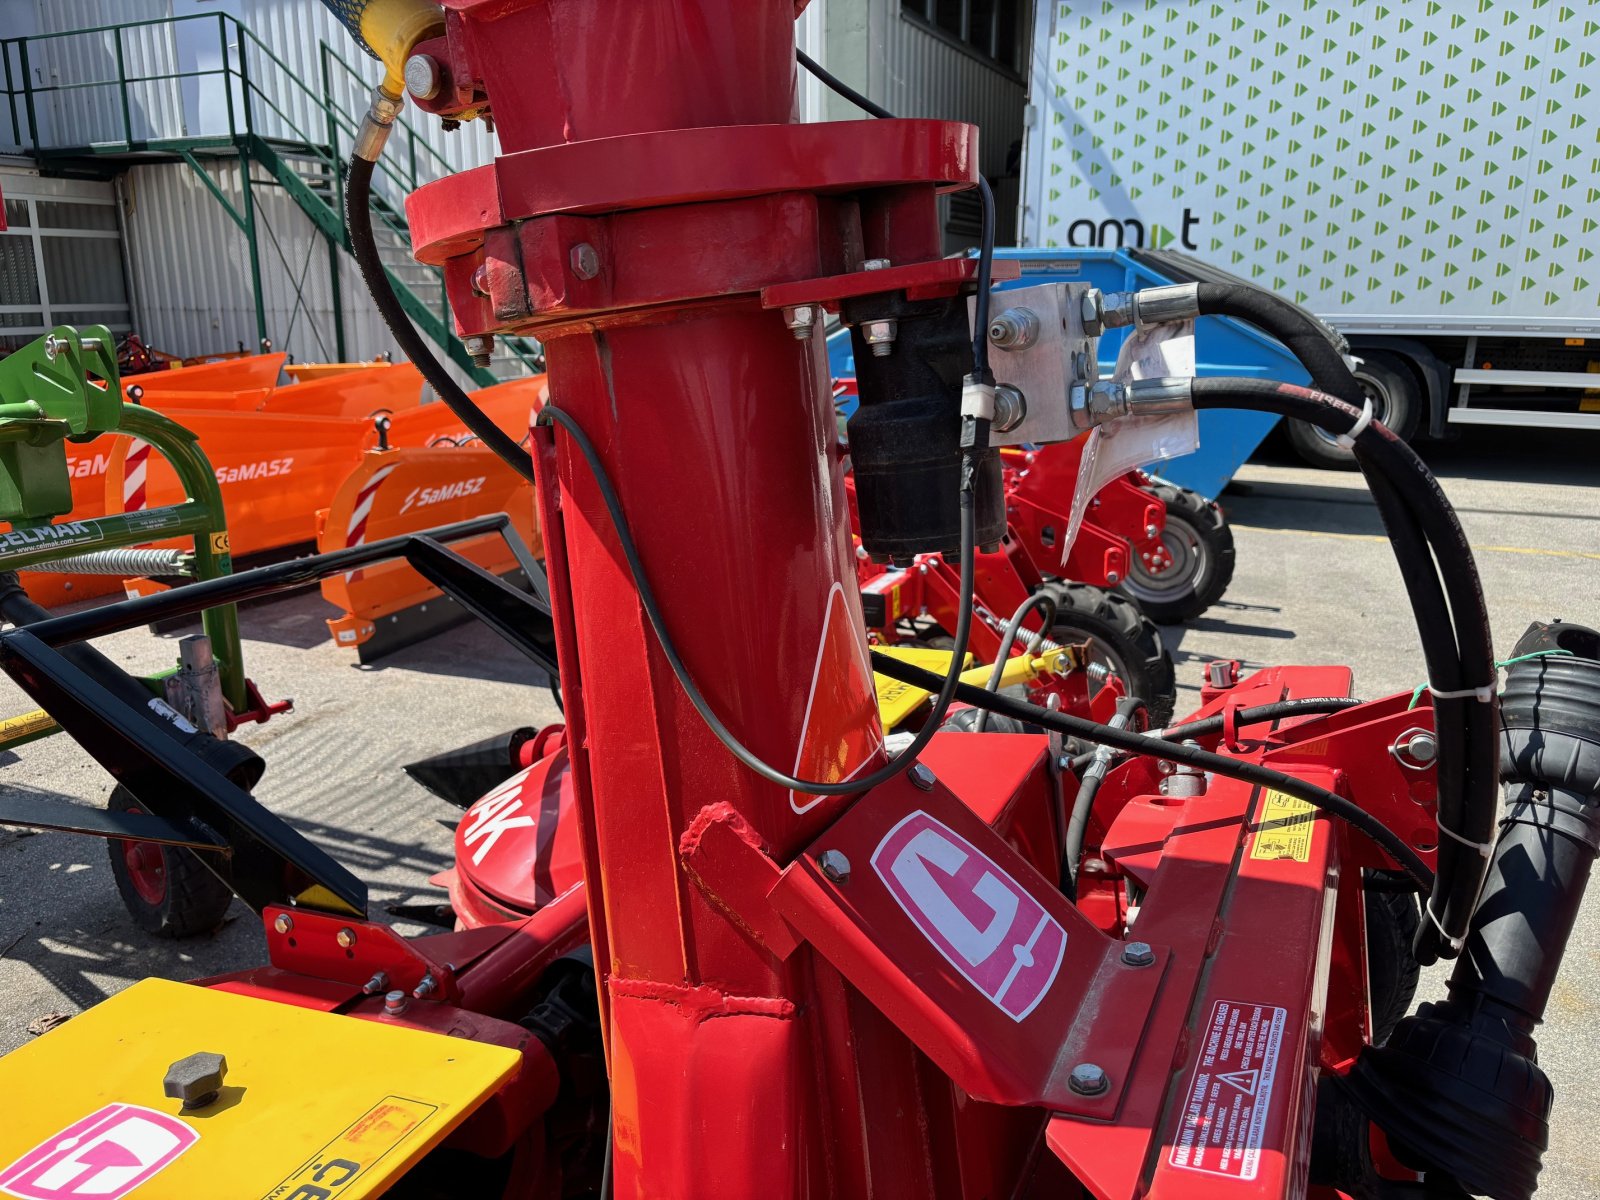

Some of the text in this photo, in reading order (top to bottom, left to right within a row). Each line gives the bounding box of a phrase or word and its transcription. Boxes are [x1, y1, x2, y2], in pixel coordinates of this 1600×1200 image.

[1310, 390, 1364, 419] FIREFL
[67, 454, 109, 477] SaM
[216, 458, 294, 484] SaMASZ
[1424, 472, 1436, 489] EN
[416, 476, 487, 507] SaMASZ
[16, 539, 74, 553] www.celmak.com
[1215, 1003, 1229, 1025] GREASED
[1206, 1031, 1221, 1055] MACHINE
[1247, 1030, 1256, 1042] AFTER
[1244, 1042, 1254, 1056] GREASE
[1256, 1042, 1265, 1050] USE
[1203, 1055, 1215, 1066] THE
[1241, 1056, 1250, 1069] CHECK
[1263, 1072, 1271, 1081] THIS
[1192, 1073, 1210, 1102] TAMAMDIR.
[1210, 1082, 1221, 1098] SEFER
[1185, 1103, 1202, 1127] YAĞLARI
[1212, 1129, 1222, 1143] GRES
[1237, 1120, 1248, 1141] KONTROL
[1222, 1141, 1232, 1158] SEZON
[1220, 1158, 1229, 1170] HER
